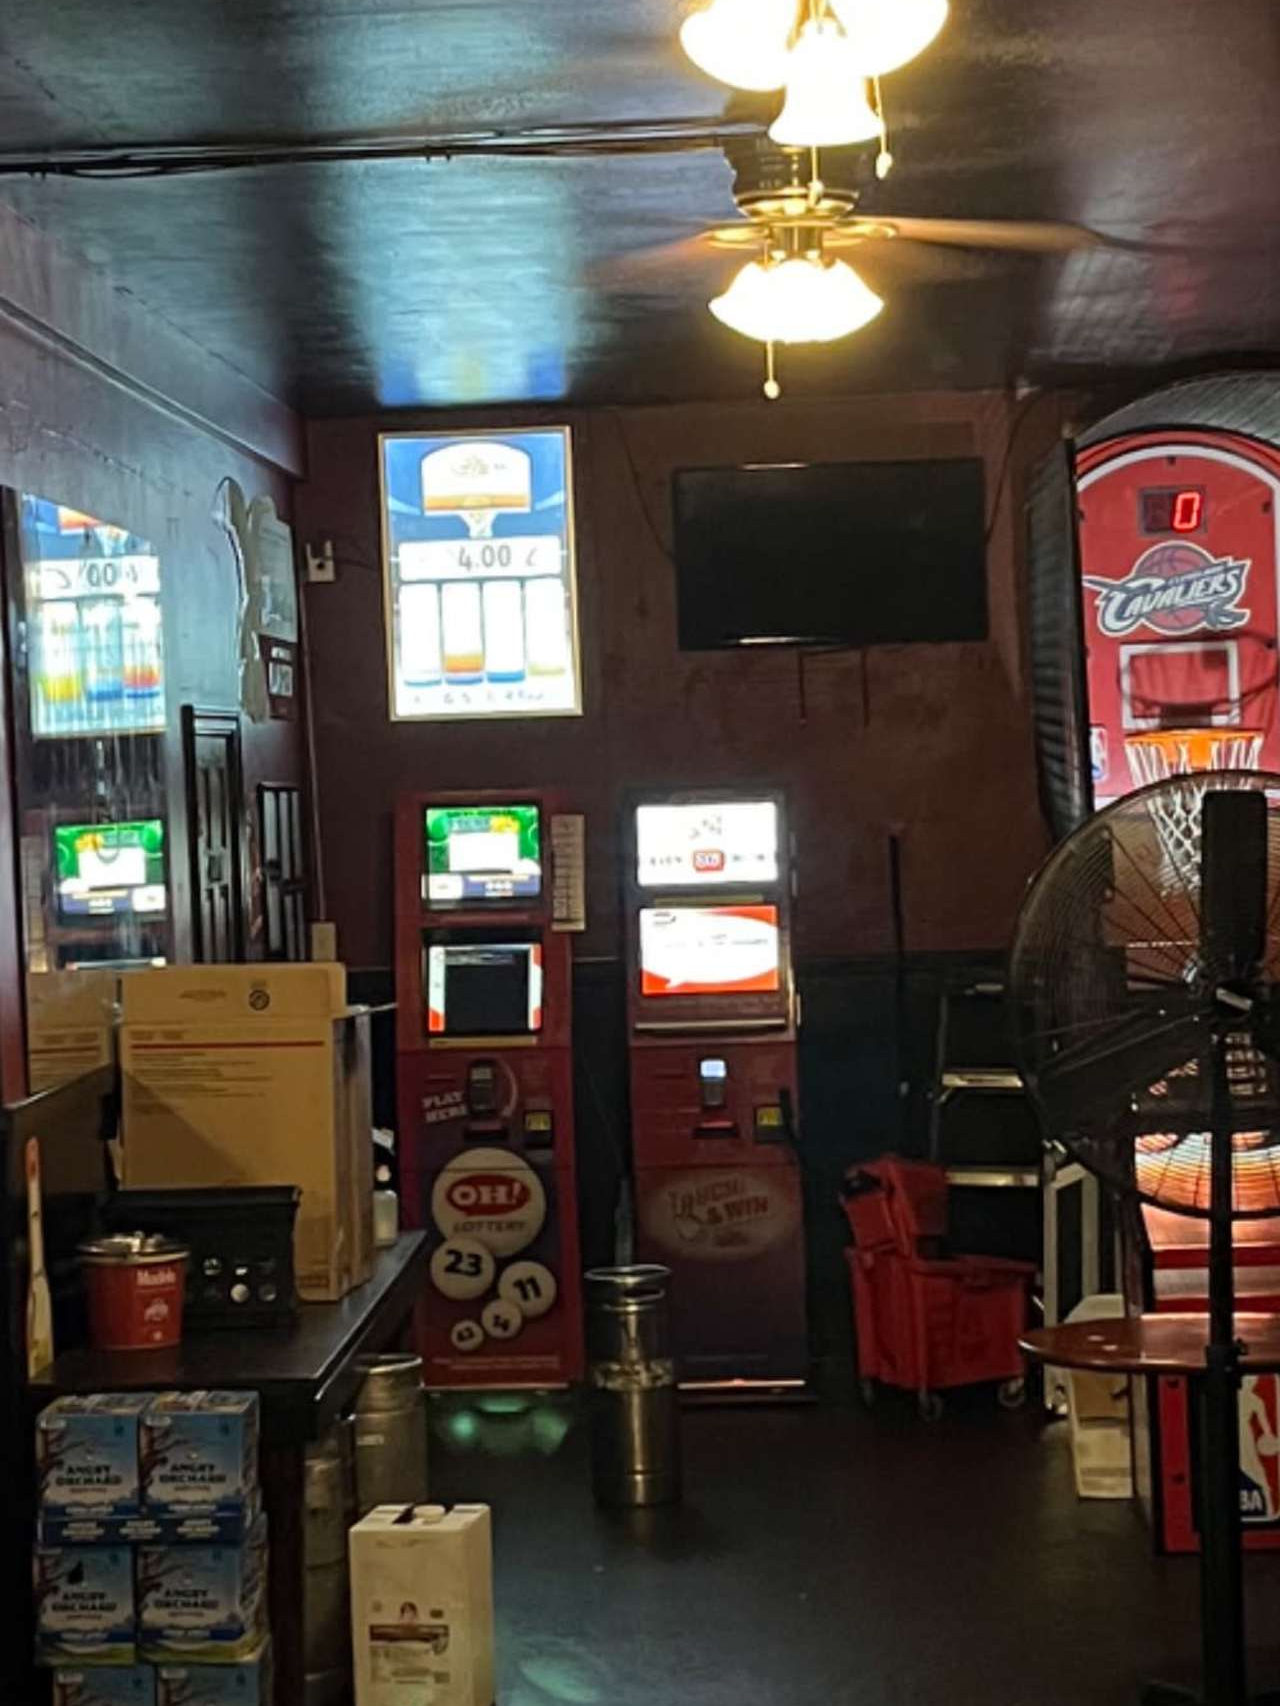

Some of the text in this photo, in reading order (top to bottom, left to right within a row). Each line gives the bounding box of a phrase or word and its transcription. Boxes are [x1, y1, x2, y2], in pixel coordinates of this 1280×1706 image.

[1172, 491, 1201, 531] 0
[450, 1181, 524, 1209] OH!
[453, 1219, 527, 1235] LOTTERY
[443, 1249, 483, 1277] 23
[66, 1464, 111, 1475] ANGRY
[171, 1463, 215, 1474] ANGRY
[55, 1476, 122, 1486] ORCHARD
[159, 1474, 226, 1484] ORCHARD
[1238, 1488, 1262, 1511] BA
